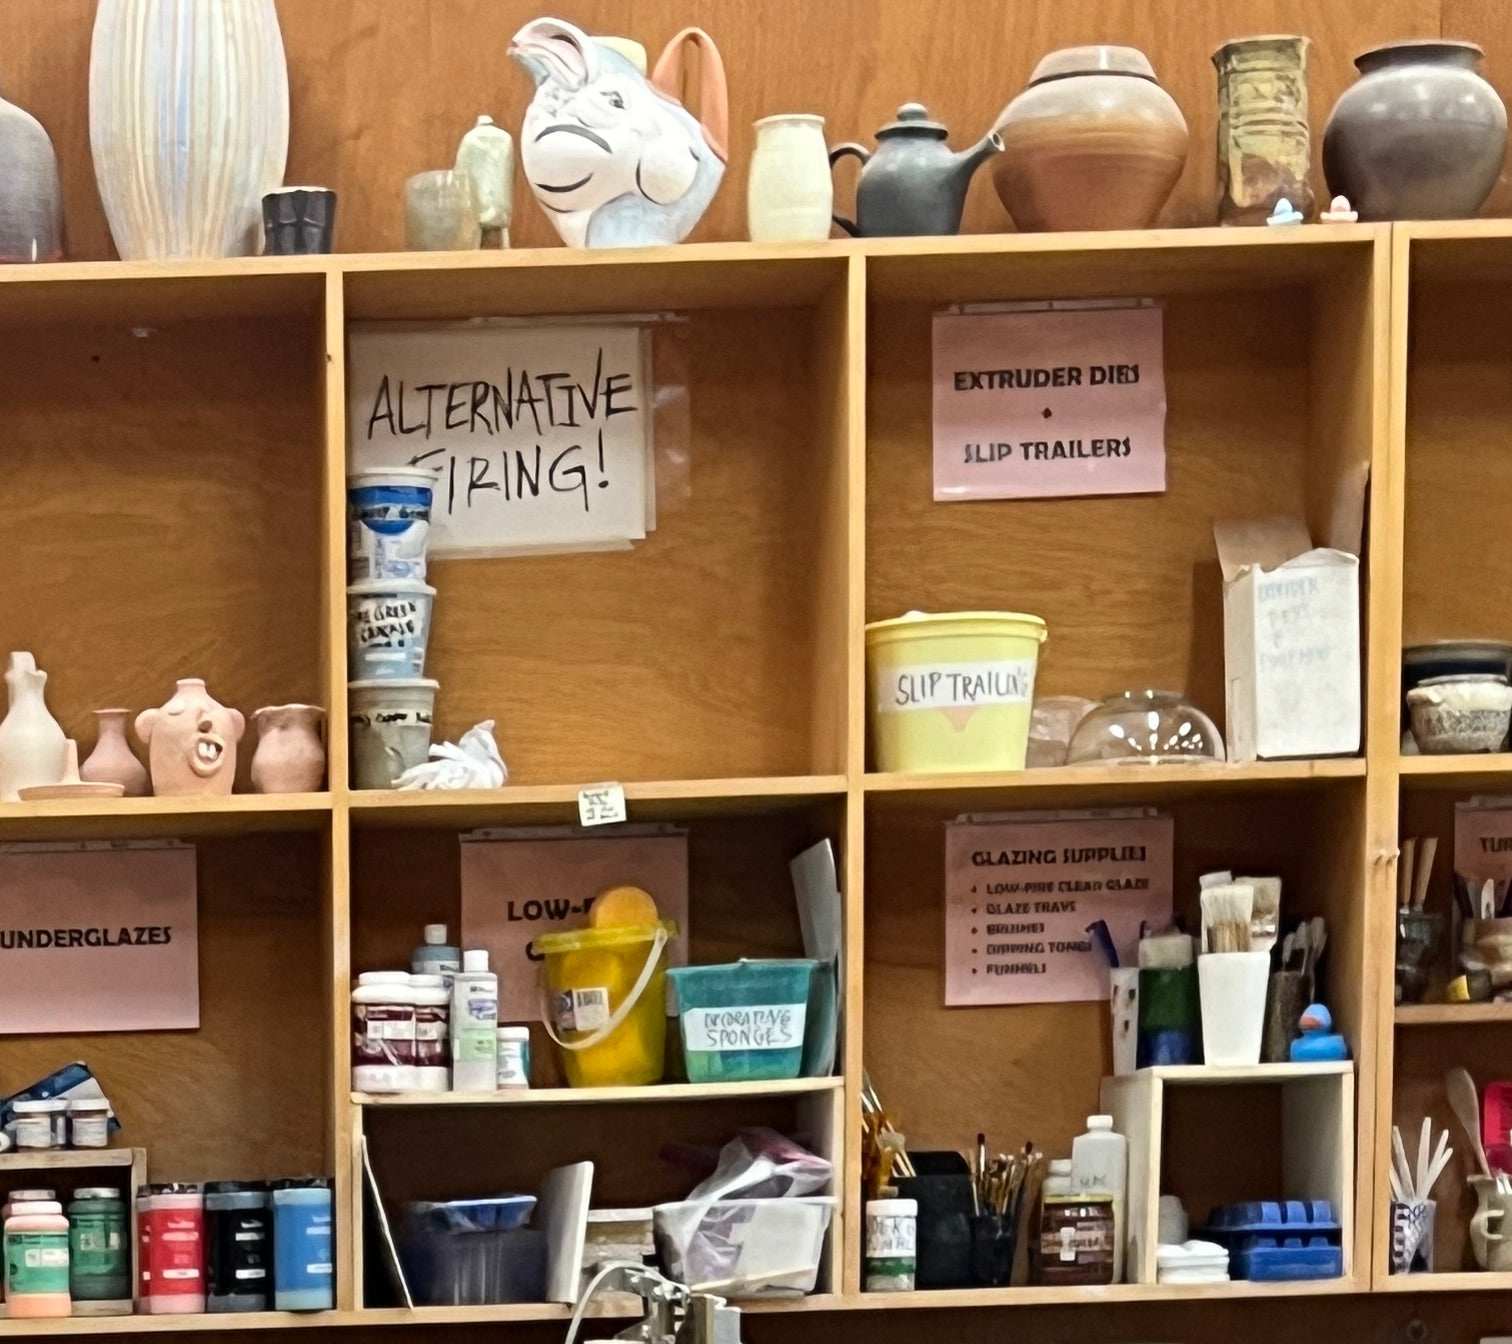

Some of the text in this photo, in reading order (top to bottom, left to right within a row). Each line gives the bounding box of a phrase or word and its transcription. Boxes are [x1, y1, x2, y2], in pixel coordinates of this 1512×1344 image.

[954, 366, 1082, 391] EXTRUDER
[367, 347, 638, 440] ALTERNATIVE
[964, 436, 1132, 463] SLIP TRAILERS
[896, 672, 942, 705] SLIP
[972, 849, 1058, 867] GLAZING
[0, 926, 172, 950] UNDERGLAZES
[707, 1028, 792, 1048] SPONGES
